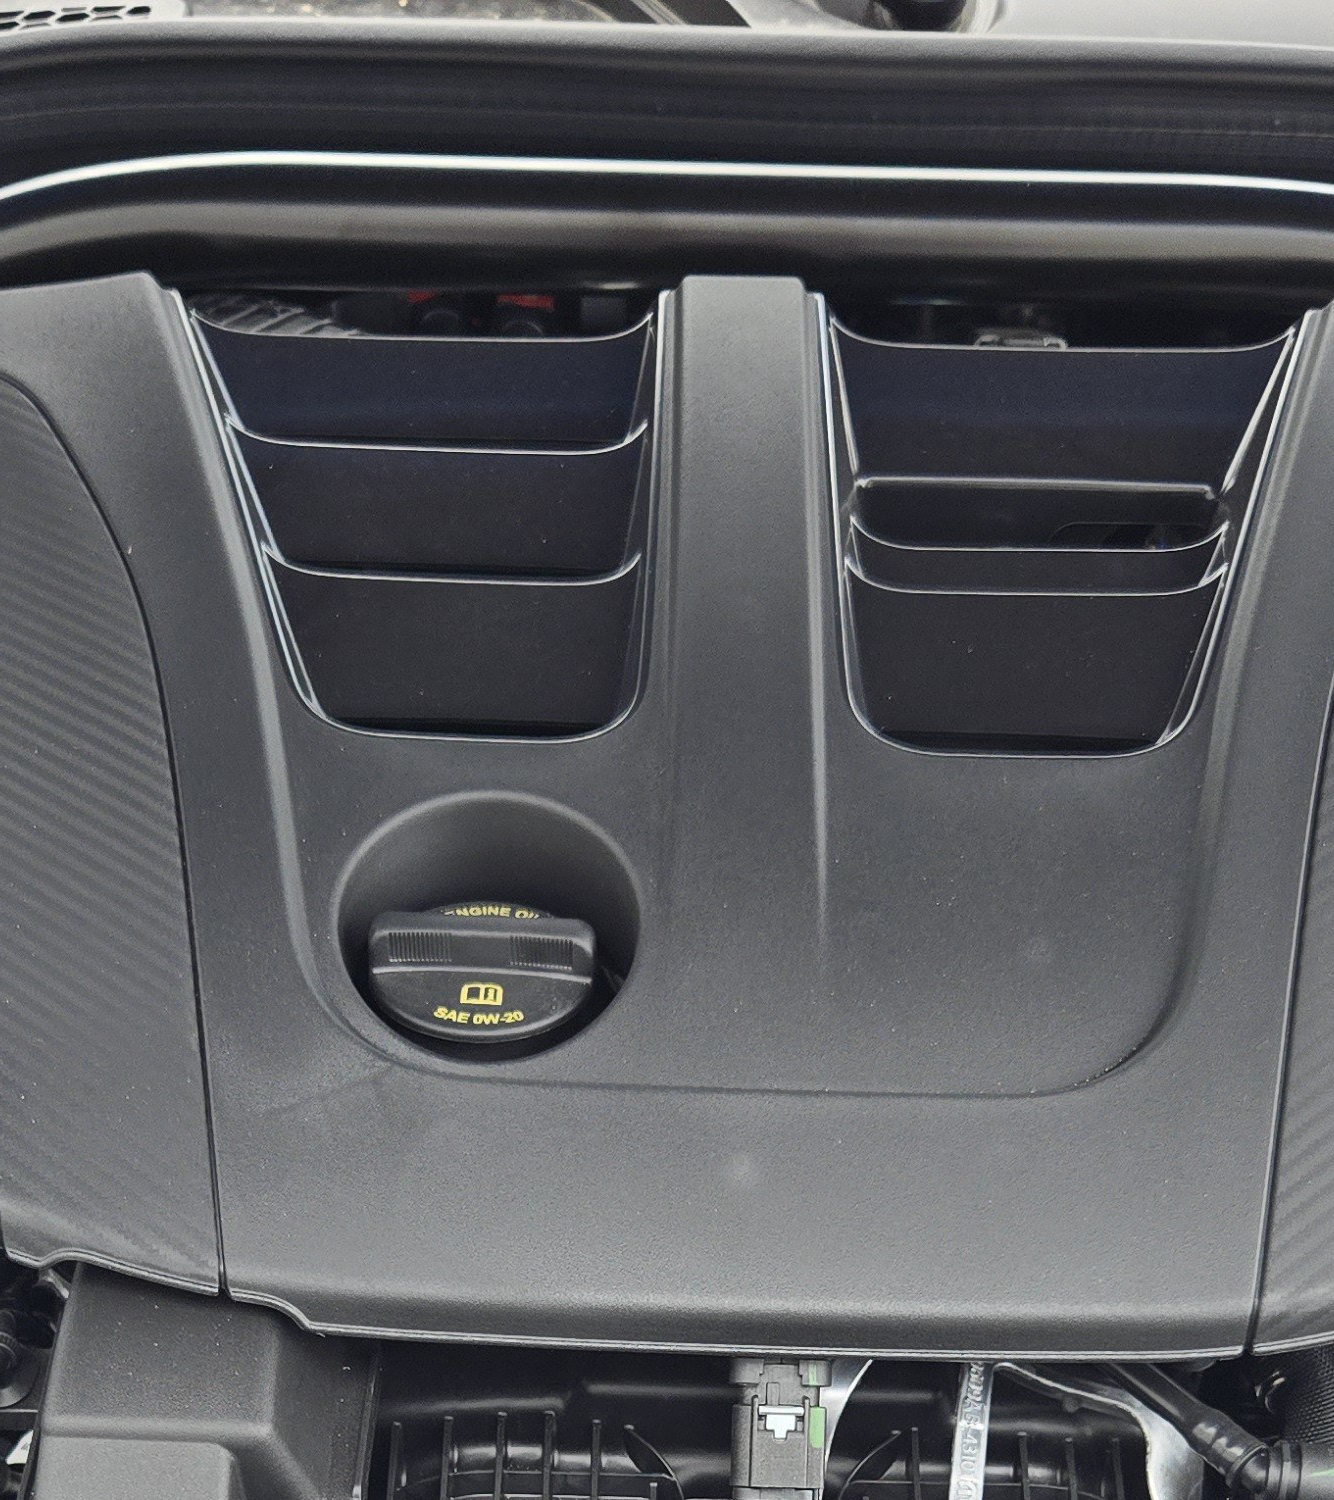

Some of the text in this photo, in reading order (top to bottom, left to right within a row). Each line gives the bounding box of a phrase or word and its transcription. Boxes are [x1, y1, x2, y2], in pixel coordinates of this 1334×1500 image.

[441, 906, 511, 918] NGINE
[433, 1006, 525, 1026] SAE 0W-20
